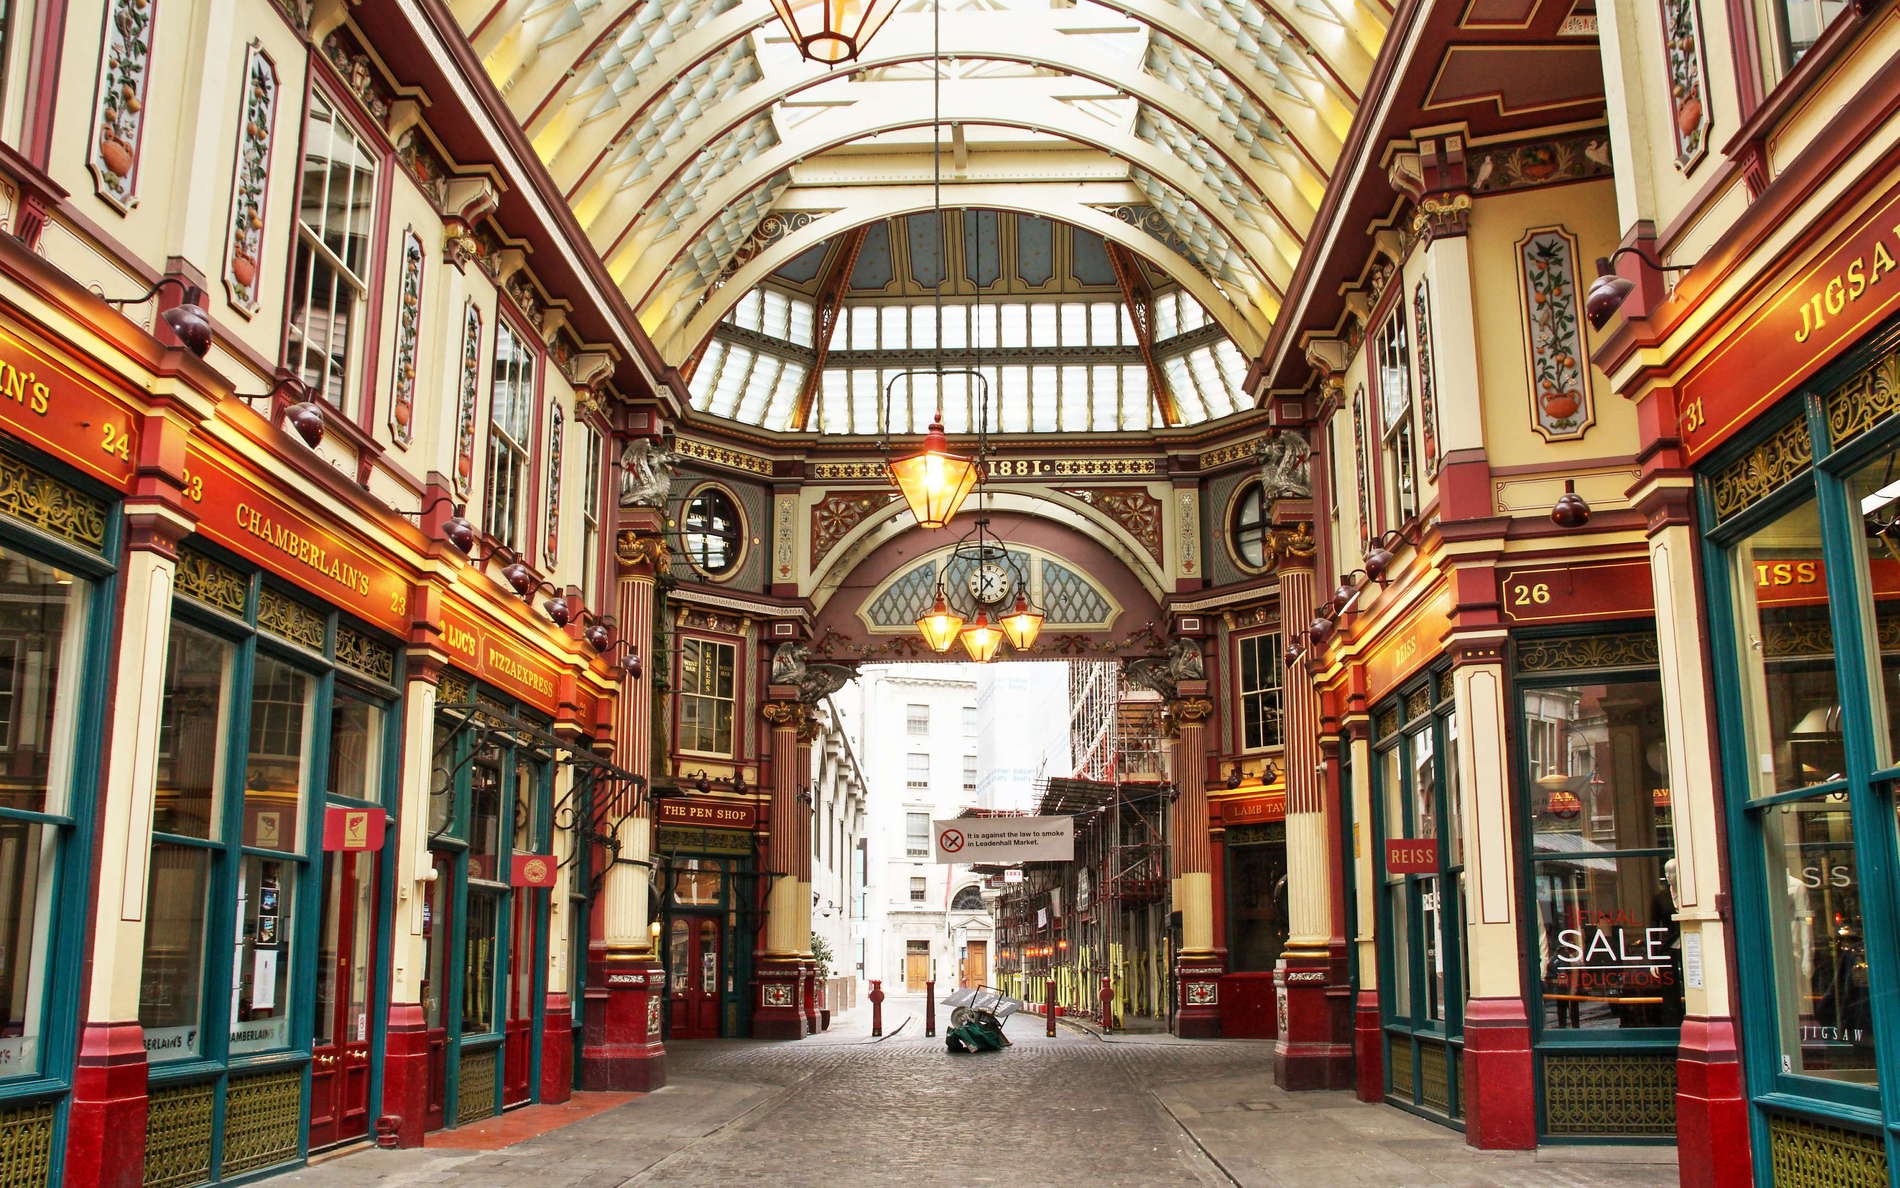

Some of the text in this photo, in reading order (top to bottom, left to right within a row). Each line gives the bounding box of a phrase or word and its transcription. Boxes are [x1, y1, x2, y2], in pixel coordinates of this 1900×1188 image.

[1686, 224, 1900, 433] 31 JIGSA
[101, 422, 130, 462] 24
[988, 461, 1042, 476] 1881
[236, 503, 370, 596] CHAMBERLAIN'S
[390, 592, 407, 616] 23
[1514, 583, 1551, 606] 26
[448, 624, 476, 657] LUC'S
[488, 647, 554, 698] PIZZAEXPRESS
[663, 805, 747, 820] THE PEN SHOP
[1234, 804, 1262, 817] LAMB
[975, 839, 1013, 847] Leadenhall
[981, 832, 1006, 840] against
[1019, 830, 1031, 838] law
[1391, 848, 1434, 864] REISS
[1577, 908, 1645, 926] FINAL
[1557, 927, 1672, 962] SALE
[1557, 970, 1675, 987] REDUCTIONS
[1803, 1025, 1864, 1042] JIGSAW
